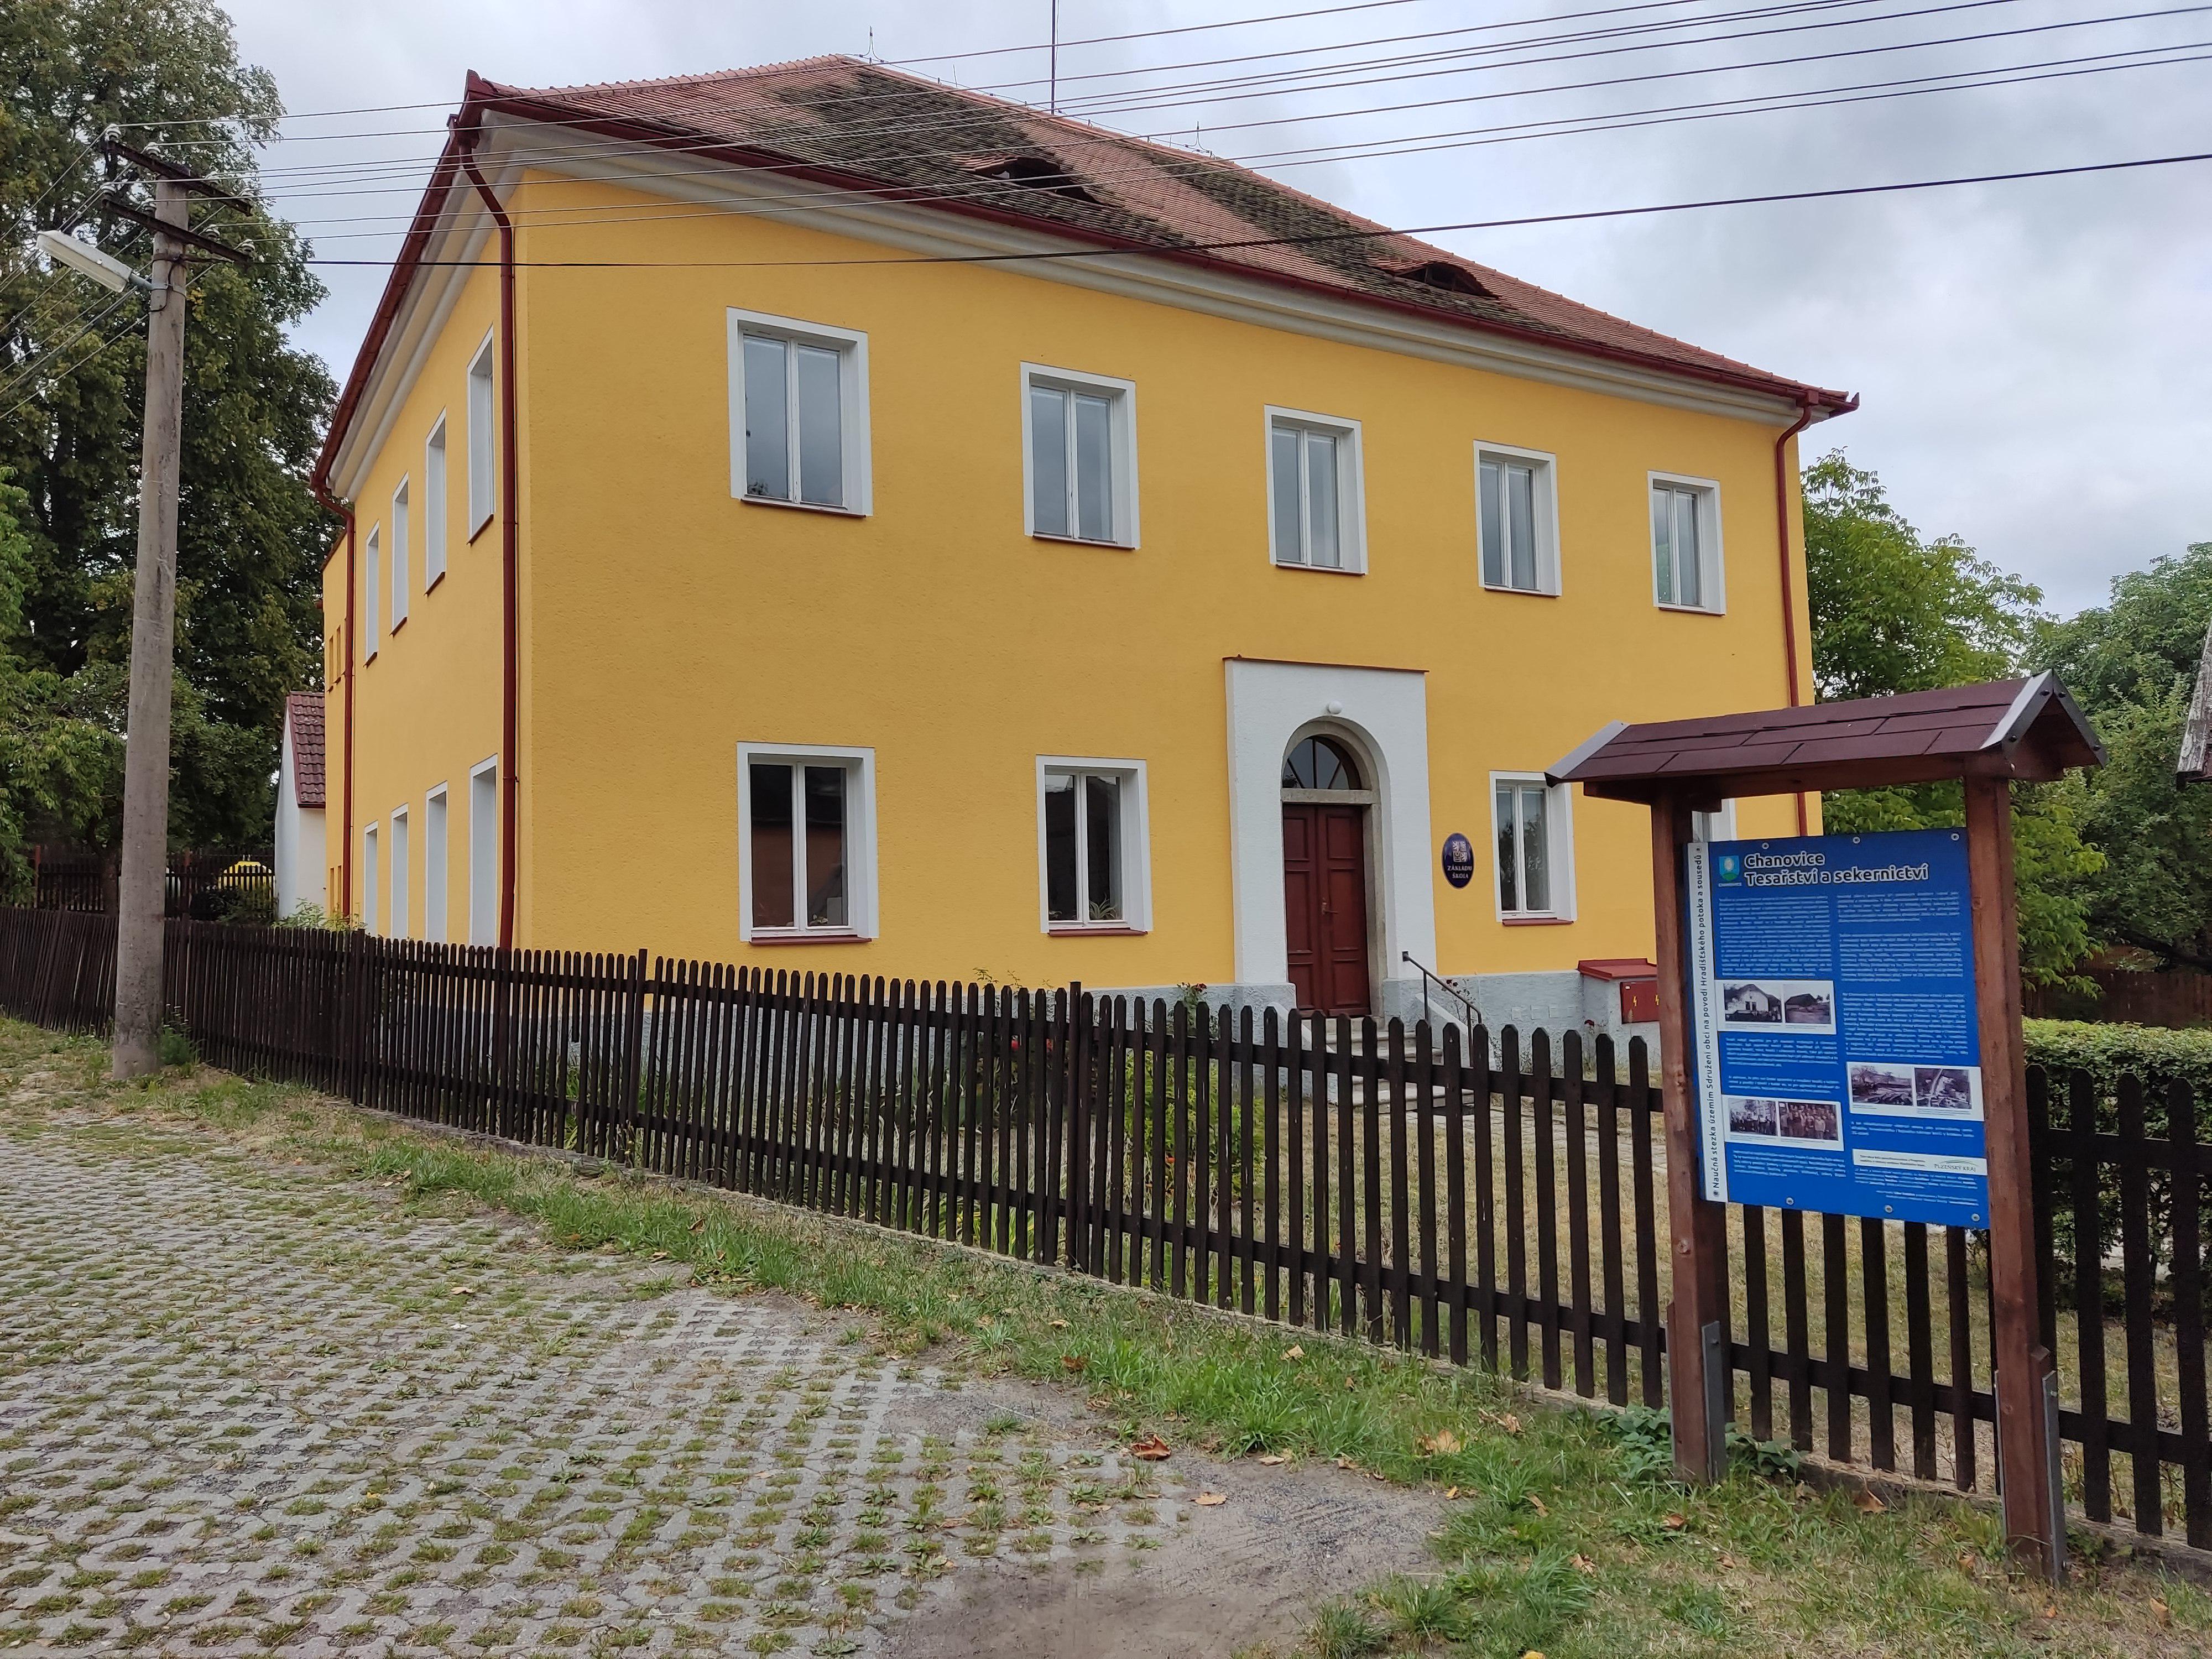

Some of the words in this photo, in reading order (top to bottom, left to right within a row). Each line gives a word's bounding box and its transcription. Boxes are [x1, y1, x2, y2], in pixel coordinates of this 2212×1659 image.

[1694, 854, 1703, 889] sousedů
[1744, 852, 1825, 868] Chanovice
[1744, 868, 1818, 886] Tesařství
[1820, 871, 1830, 883] a
[1833, 863, 1929, 883] sekernictví
[1697, 899, 1706, 927] potoka
[1700, 989, 1710, 1018] povodí
[1704, 1020, 1711, 1030] na
[1704, 1052, 1713, 1089] Sdružení
[1707, 1091, 1715, 1124] územím
[1709, 1126, 1718, 1155] stezka
[1710, 1157, 1720, 1188] Naučná
